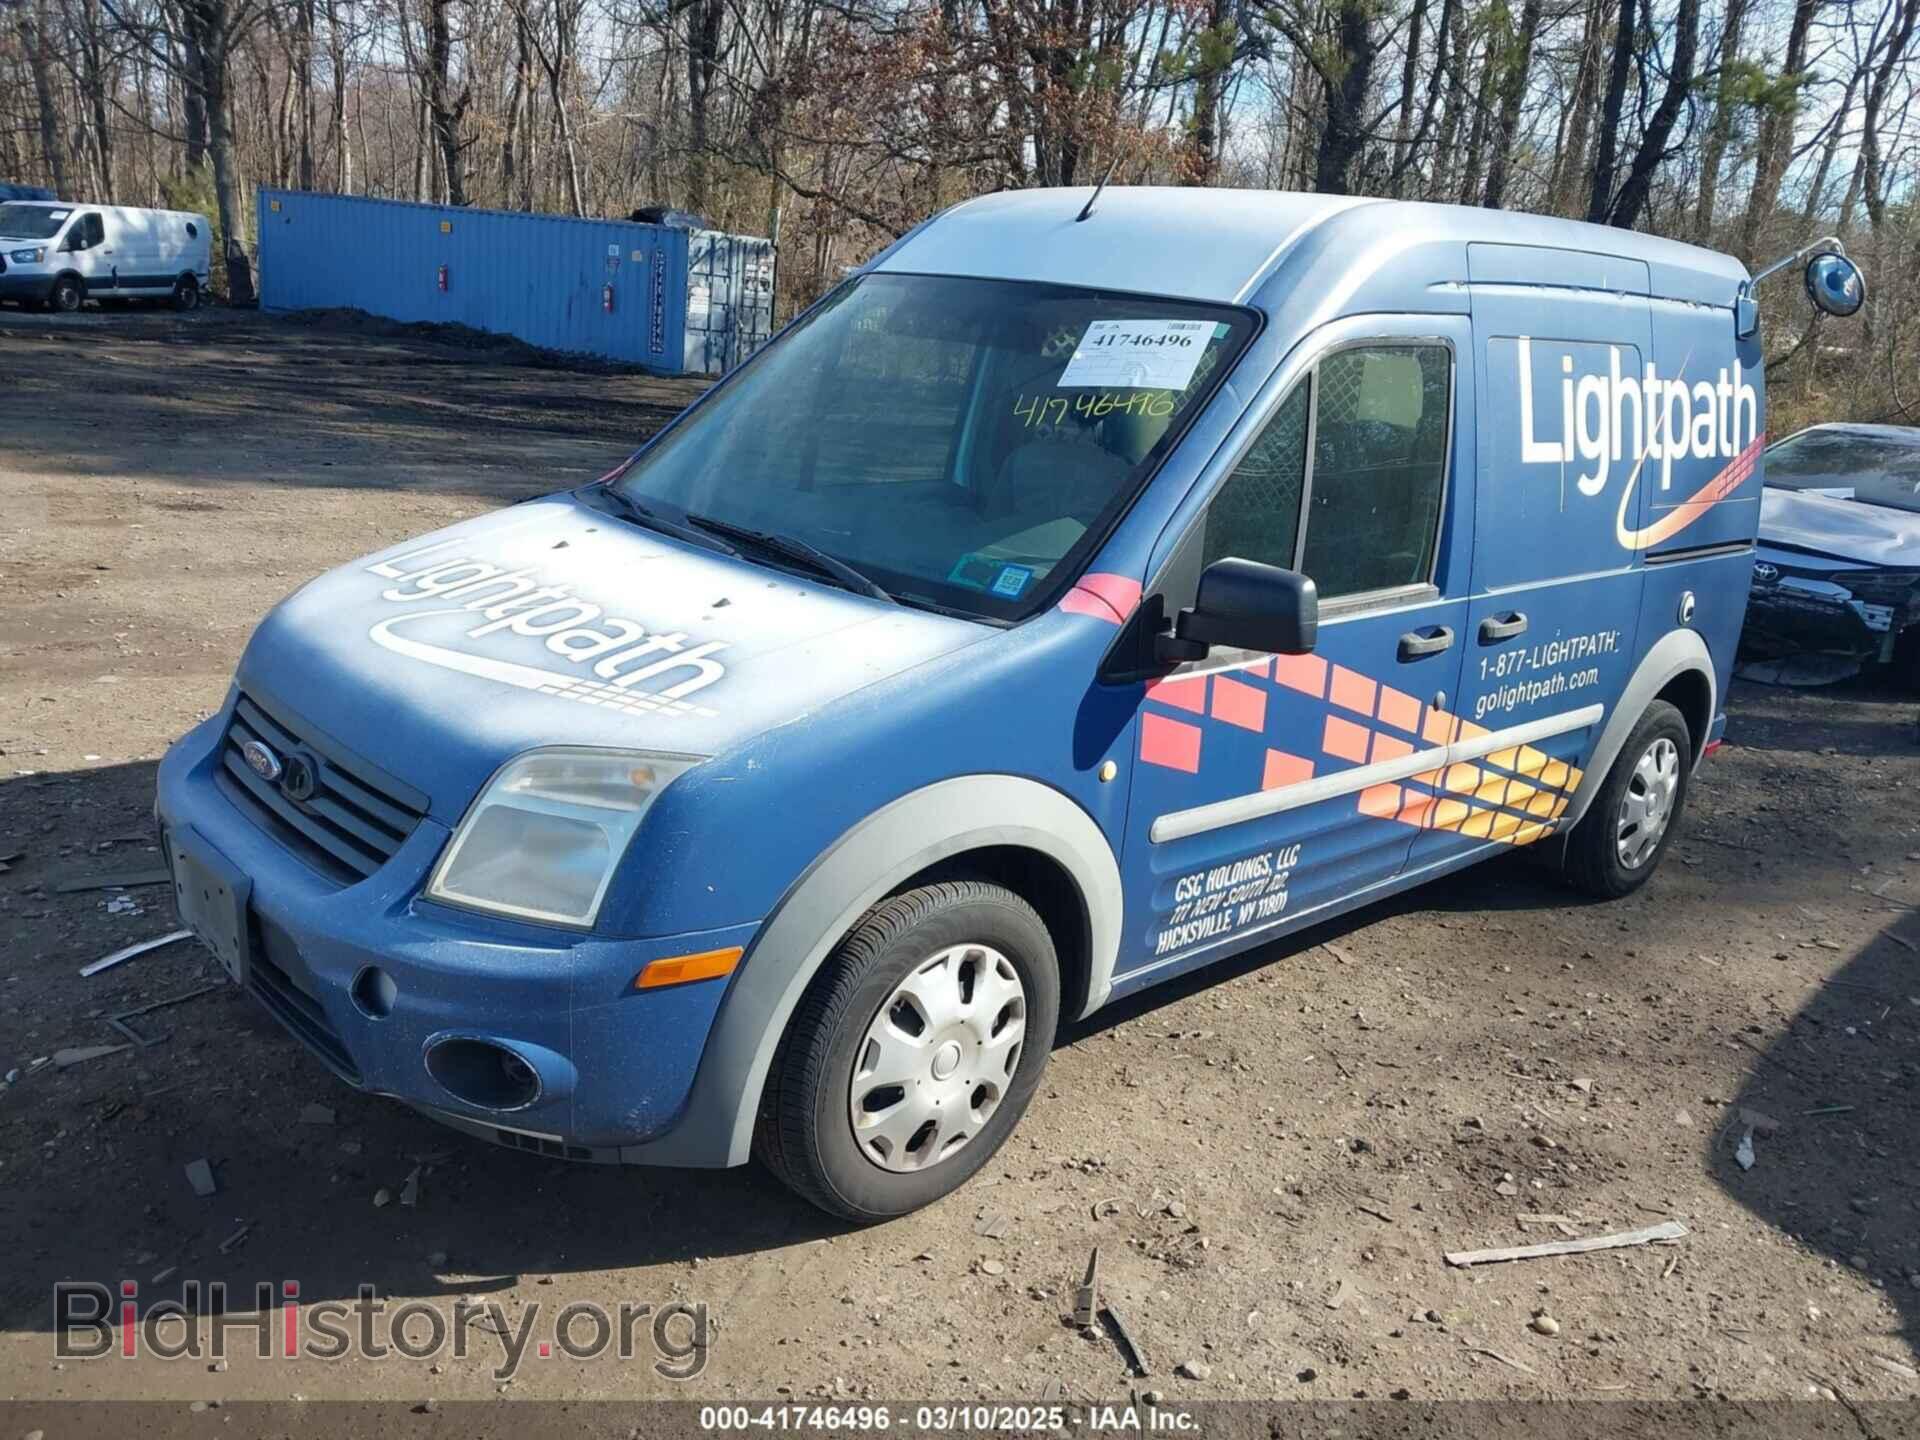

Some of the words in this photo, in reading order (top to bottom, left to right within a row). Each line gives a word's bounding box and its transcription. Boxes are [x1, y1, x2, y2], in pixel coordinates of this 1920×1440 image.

[1093, 334, 1192, 347] 41746496
[1518, 335, 1757, 497] Lightpath
[365, 538, 731, 700] Lightpath
[1175, 872, 1204, 902] CSC
[1206, 852, 1273, 893] HOLDINGS,
[1276, 844, 1301, 870] LLC
[1236, 901, 1258, 926] NY
